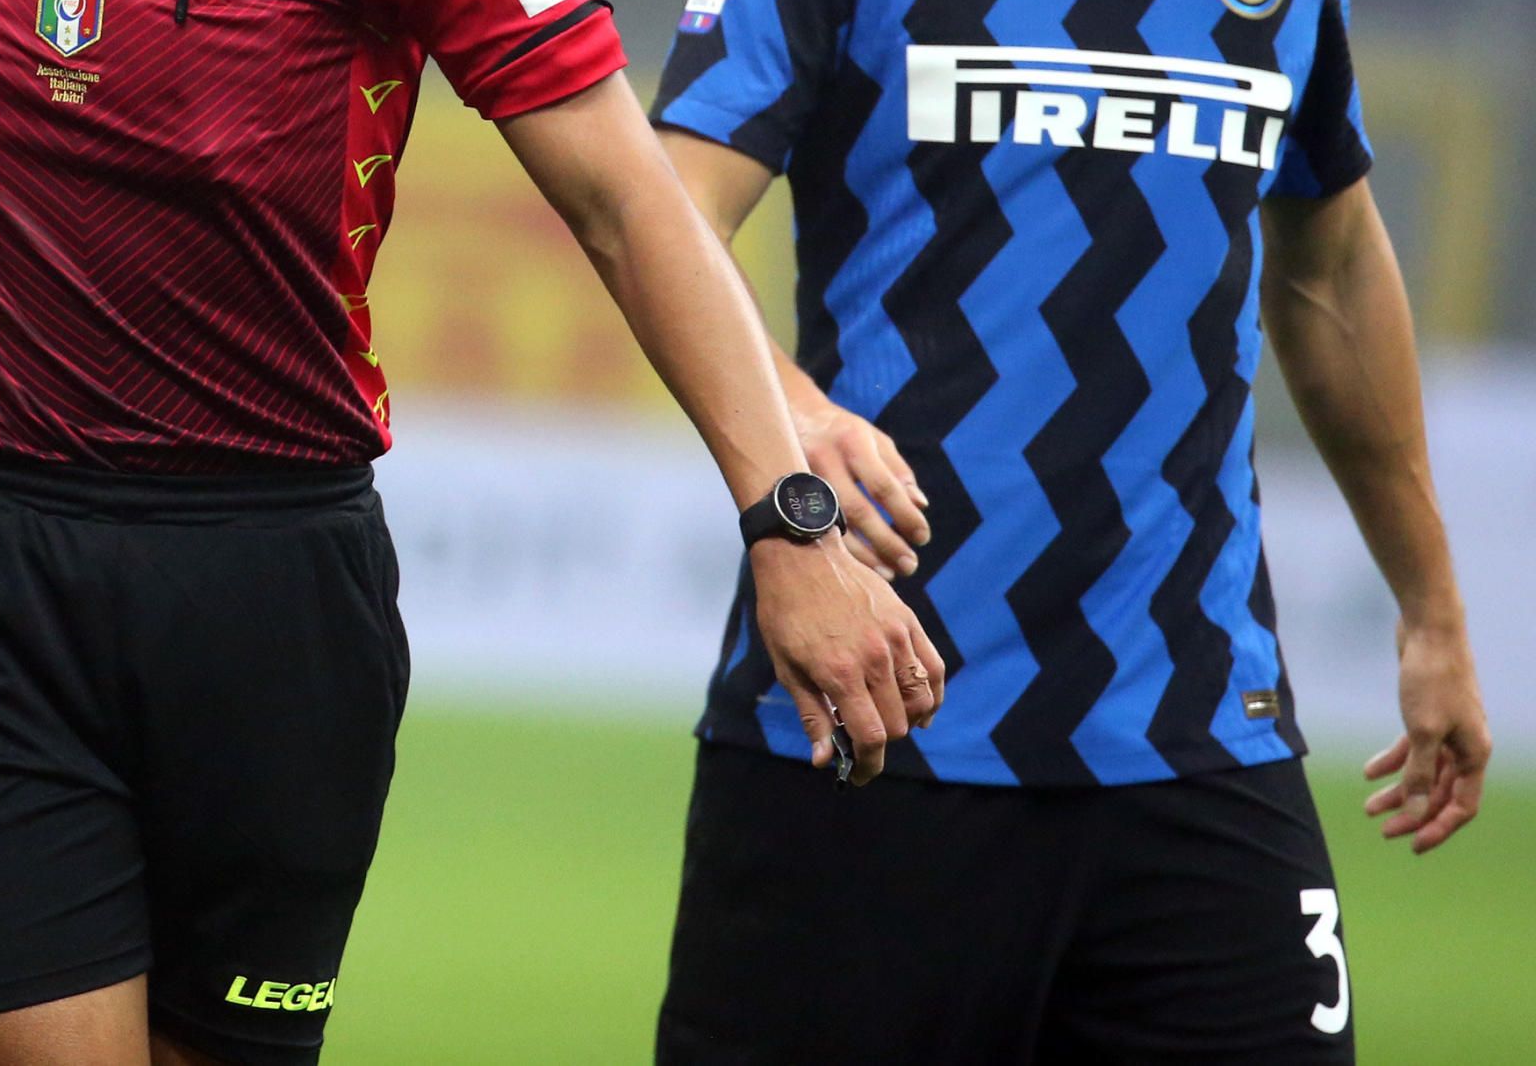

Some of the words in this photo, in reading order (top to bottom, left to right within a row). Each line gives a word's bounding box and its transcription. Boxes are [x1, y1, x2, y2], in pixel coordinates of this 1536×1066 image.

[36, 63, 100, 83] Associazione
[49, 77, 87, 93] Italiana
[52, 89, 84, 105] Arbitri
[906, 44, 1293, 171] PIRELLI
[1299, 888, 1350, 1035] 3
